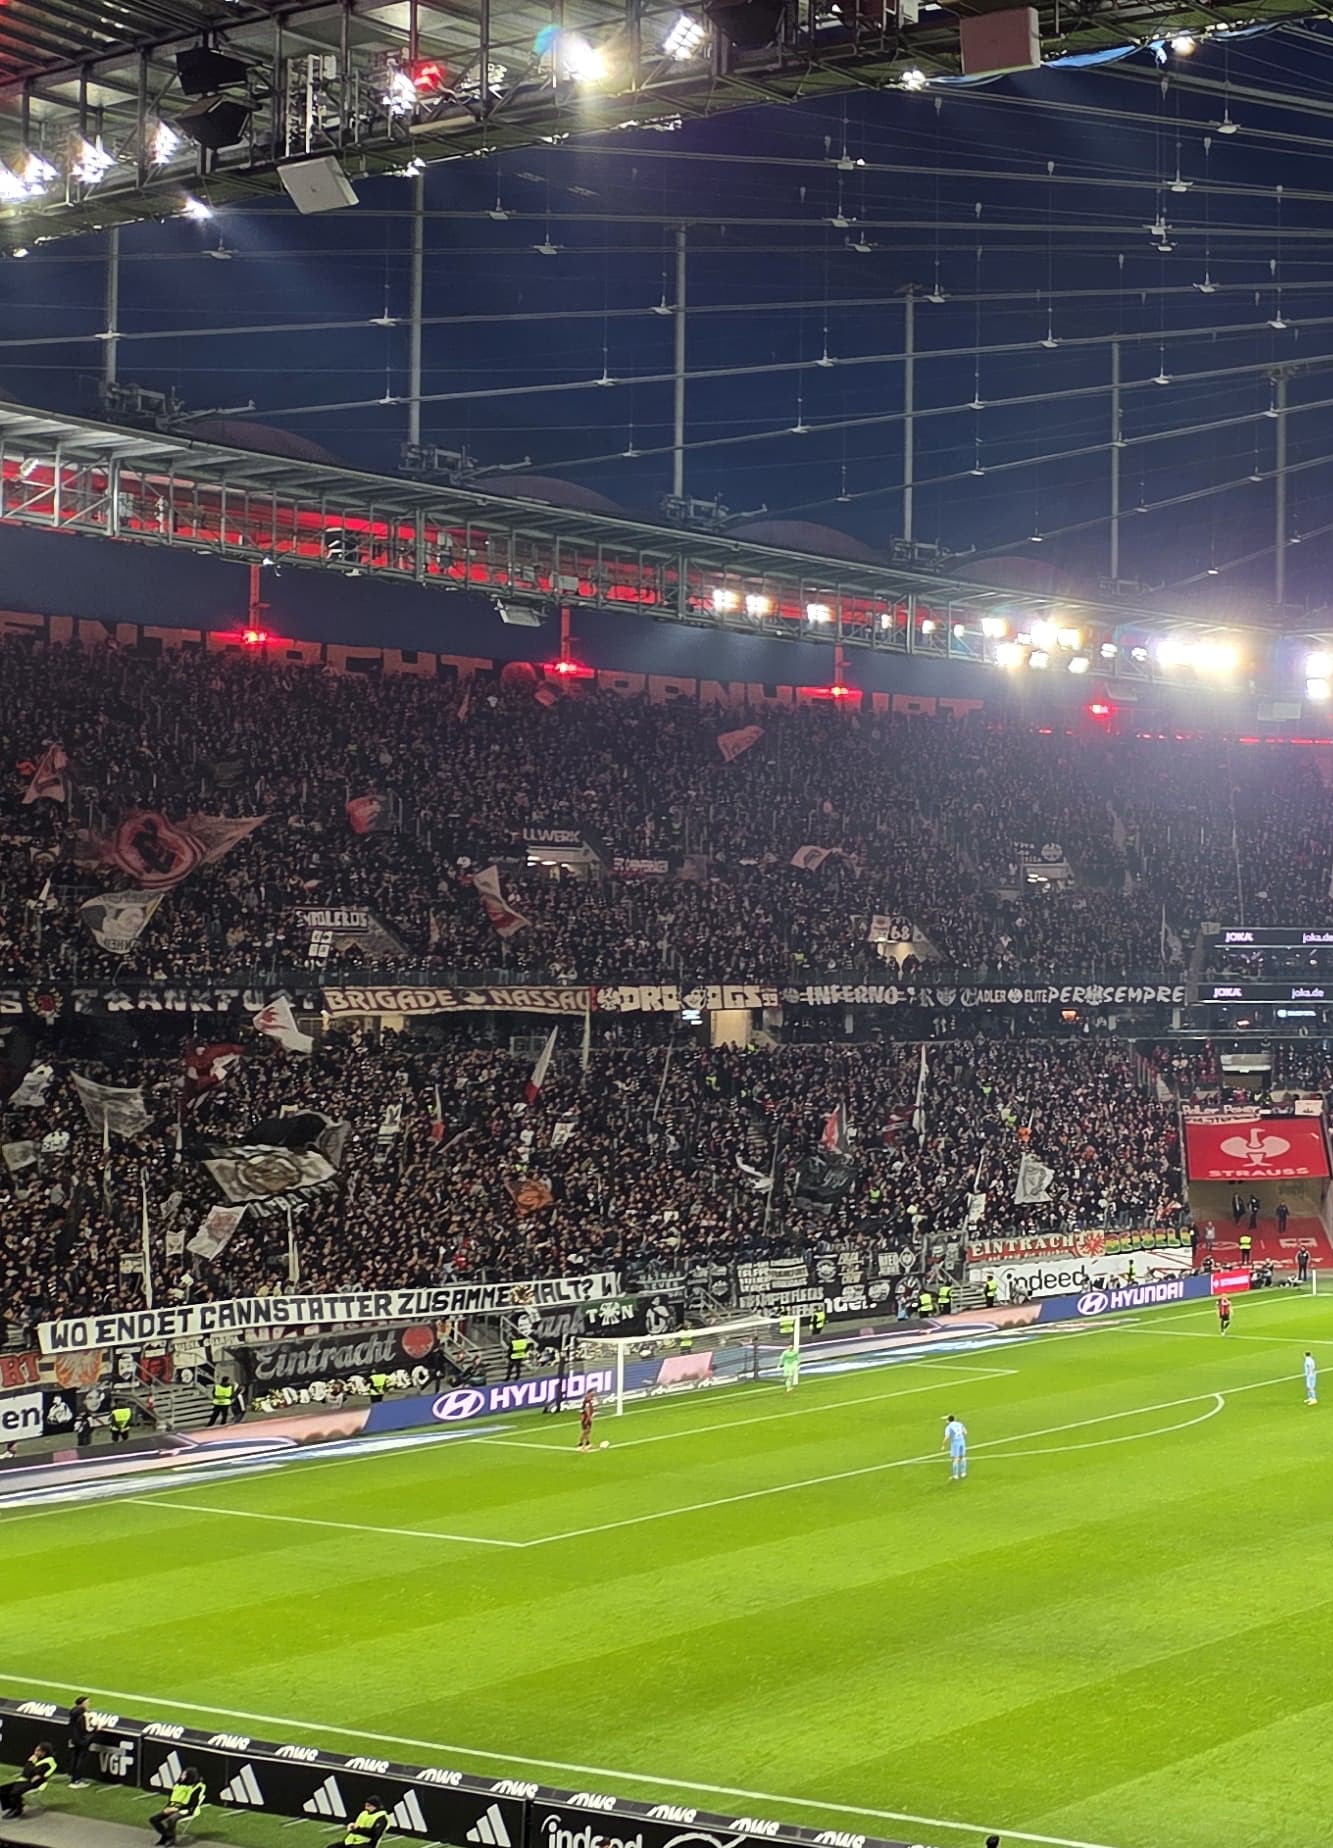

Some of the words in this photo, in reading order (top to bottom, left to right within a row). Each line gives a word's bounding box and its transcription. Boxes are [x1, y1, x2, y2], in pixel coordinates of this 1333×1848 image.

[1225, 932, 1253, 944] JOKA
[325, 990, 456, 1011] BRIGADE
[1103, 985, 1185, 1004] SEMPRE
[1214, 988, 1242, 999] JOKA
[1208, 1167, 1310, 1177] STRAUSS
[971, 1231, 1086, 1257] EINTRACHT
[1111, 1280, 1184, 1309] HYUNDAI
[51, 1322, 87, 1349] WO
[96, 1308, 196, 1344] ENDET
[201, 1291, 392, 1330] CANNSTATTER
[398, 1277, 593, 1314] ZUSAMMEHALT?
[255, 1330, 397, 1380] Eintracht
[3, 1406, 40, 1428] en
